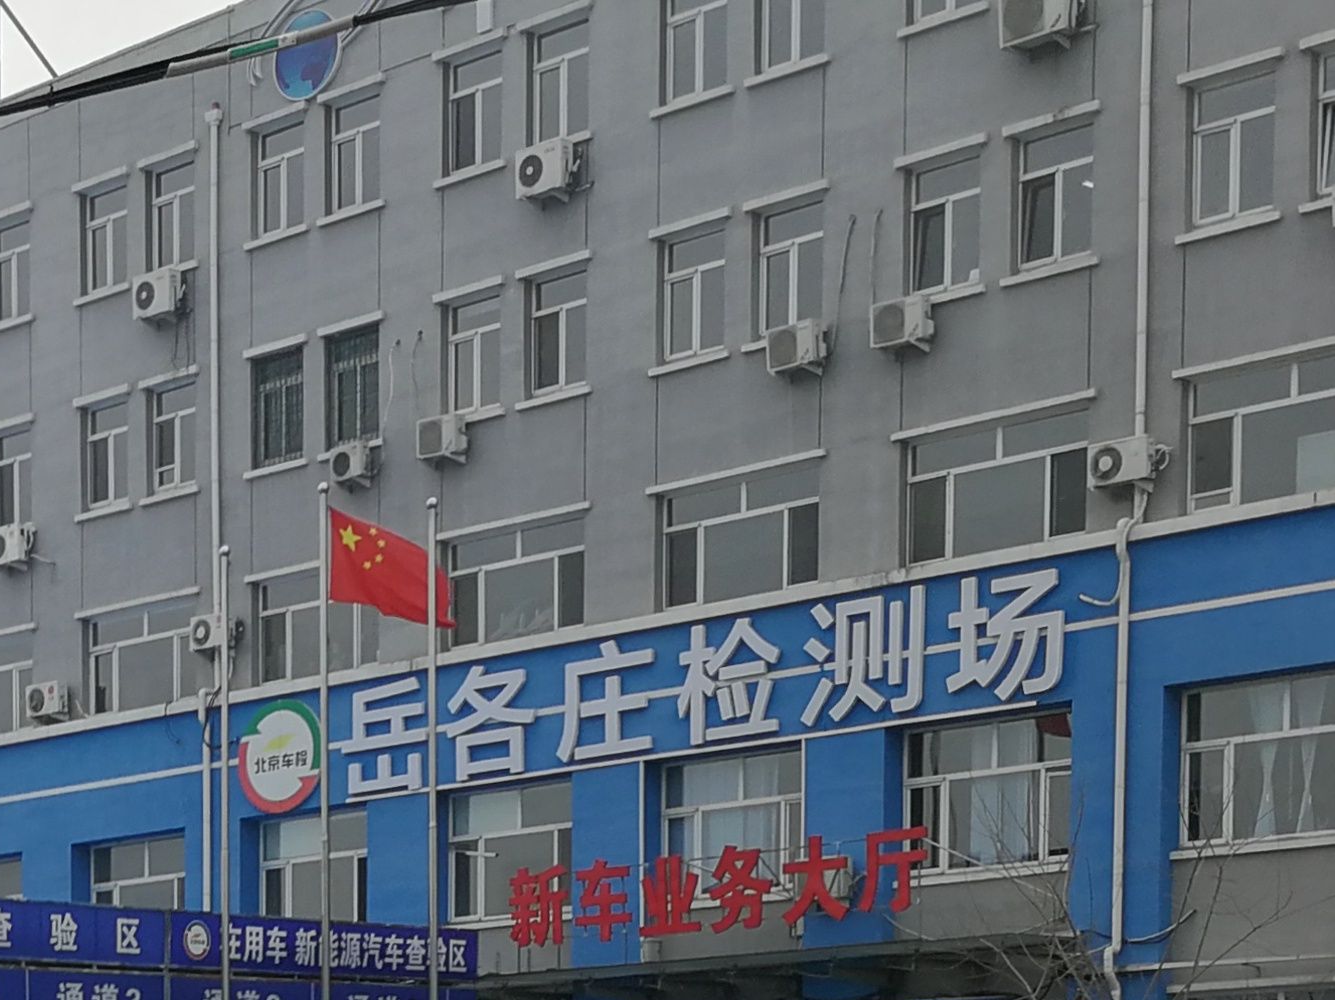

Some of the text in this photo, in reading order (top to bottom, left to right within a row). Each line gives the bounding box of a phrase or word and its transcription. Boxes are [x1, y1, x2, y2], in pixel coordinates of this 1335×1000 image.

[340, 567, 1066, 801] 岳各庄检测场
[219, 922, 468, 973] 在用车 新能源汽车查验区
[508, 825, 929, 949] 新车业务大厅
